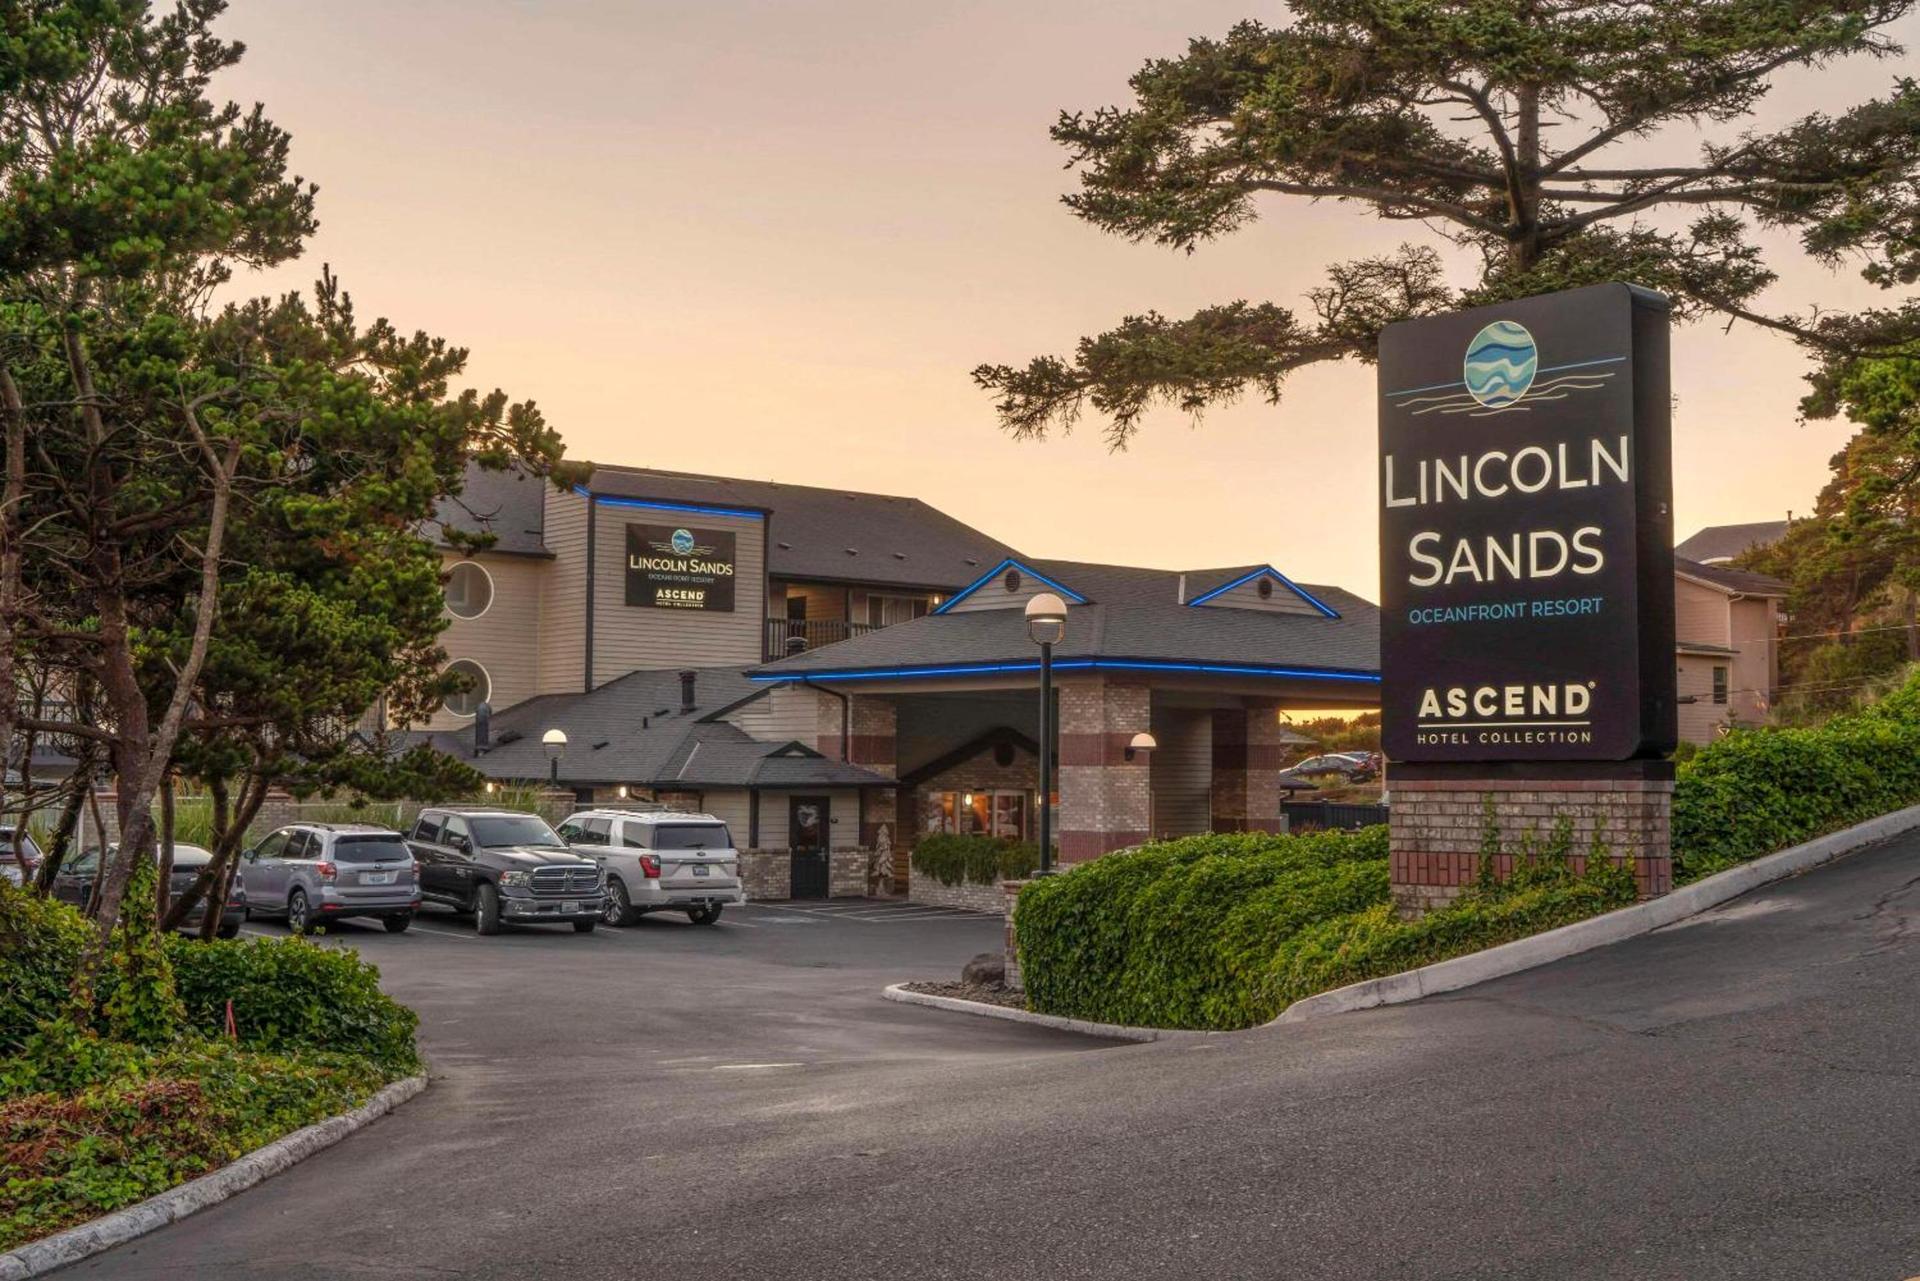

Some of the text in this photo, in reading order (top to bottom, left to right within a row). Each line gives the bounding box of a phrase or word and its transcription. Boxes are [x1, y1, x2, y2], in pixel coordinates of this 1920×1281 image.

[1385, 435, 1629, 507] LINCOLN
[630, 554, 733, 575] LINCOLN SANDS
[1409, 526, 1604, 587] SANDS
[656, 589, 704, 600] ASCEND
[1409, 597, 1602, 624] OCEANFRONT RESORT
[1417, 732, 1591, 744] HOTEL COLLECTION
